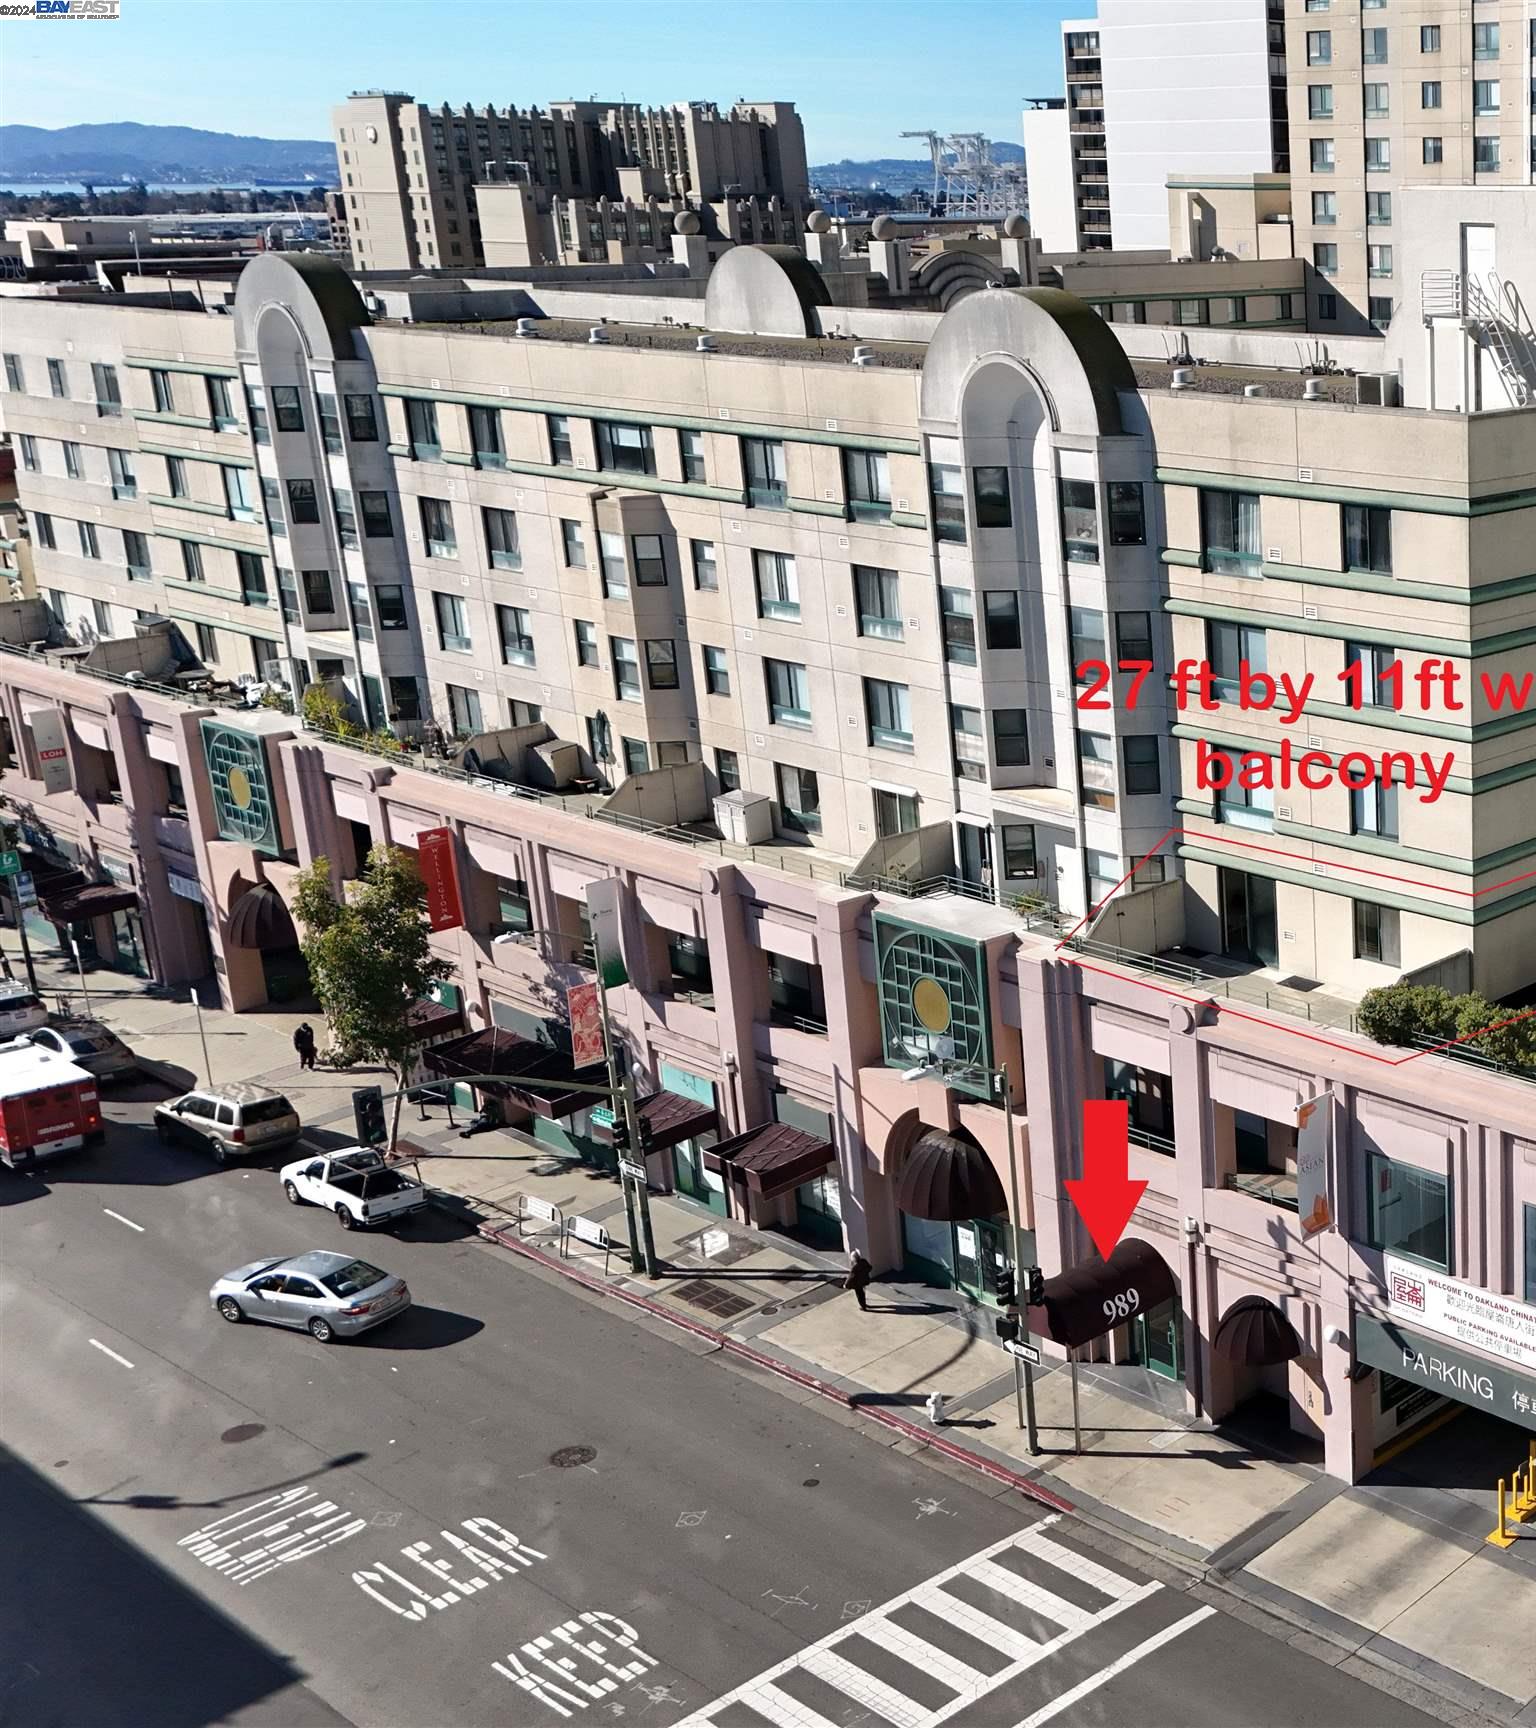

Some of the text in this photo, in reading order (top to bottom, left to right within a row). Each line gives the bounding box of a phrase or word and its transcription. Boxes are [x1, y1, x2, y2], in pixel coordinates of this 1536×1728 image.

[432, 848, 448, 913] WELLINGTON
[1102, 1288, 1140, 1325] 989
[1427, 1279, 1461, 1295] WELCOME
[1464, 1291, 1473, 1300] TO
[1475, 1295, 1509, 1313] OAKLAND
[1443, 1312, 1536, 1352] PUBLIC PARKING AVAILABLE
[1401, 1346, 1494, 1400] PARKING
[351, 1517, 549, 1621] CLEAR
[491, 1611, 660, 1717] KEEP
